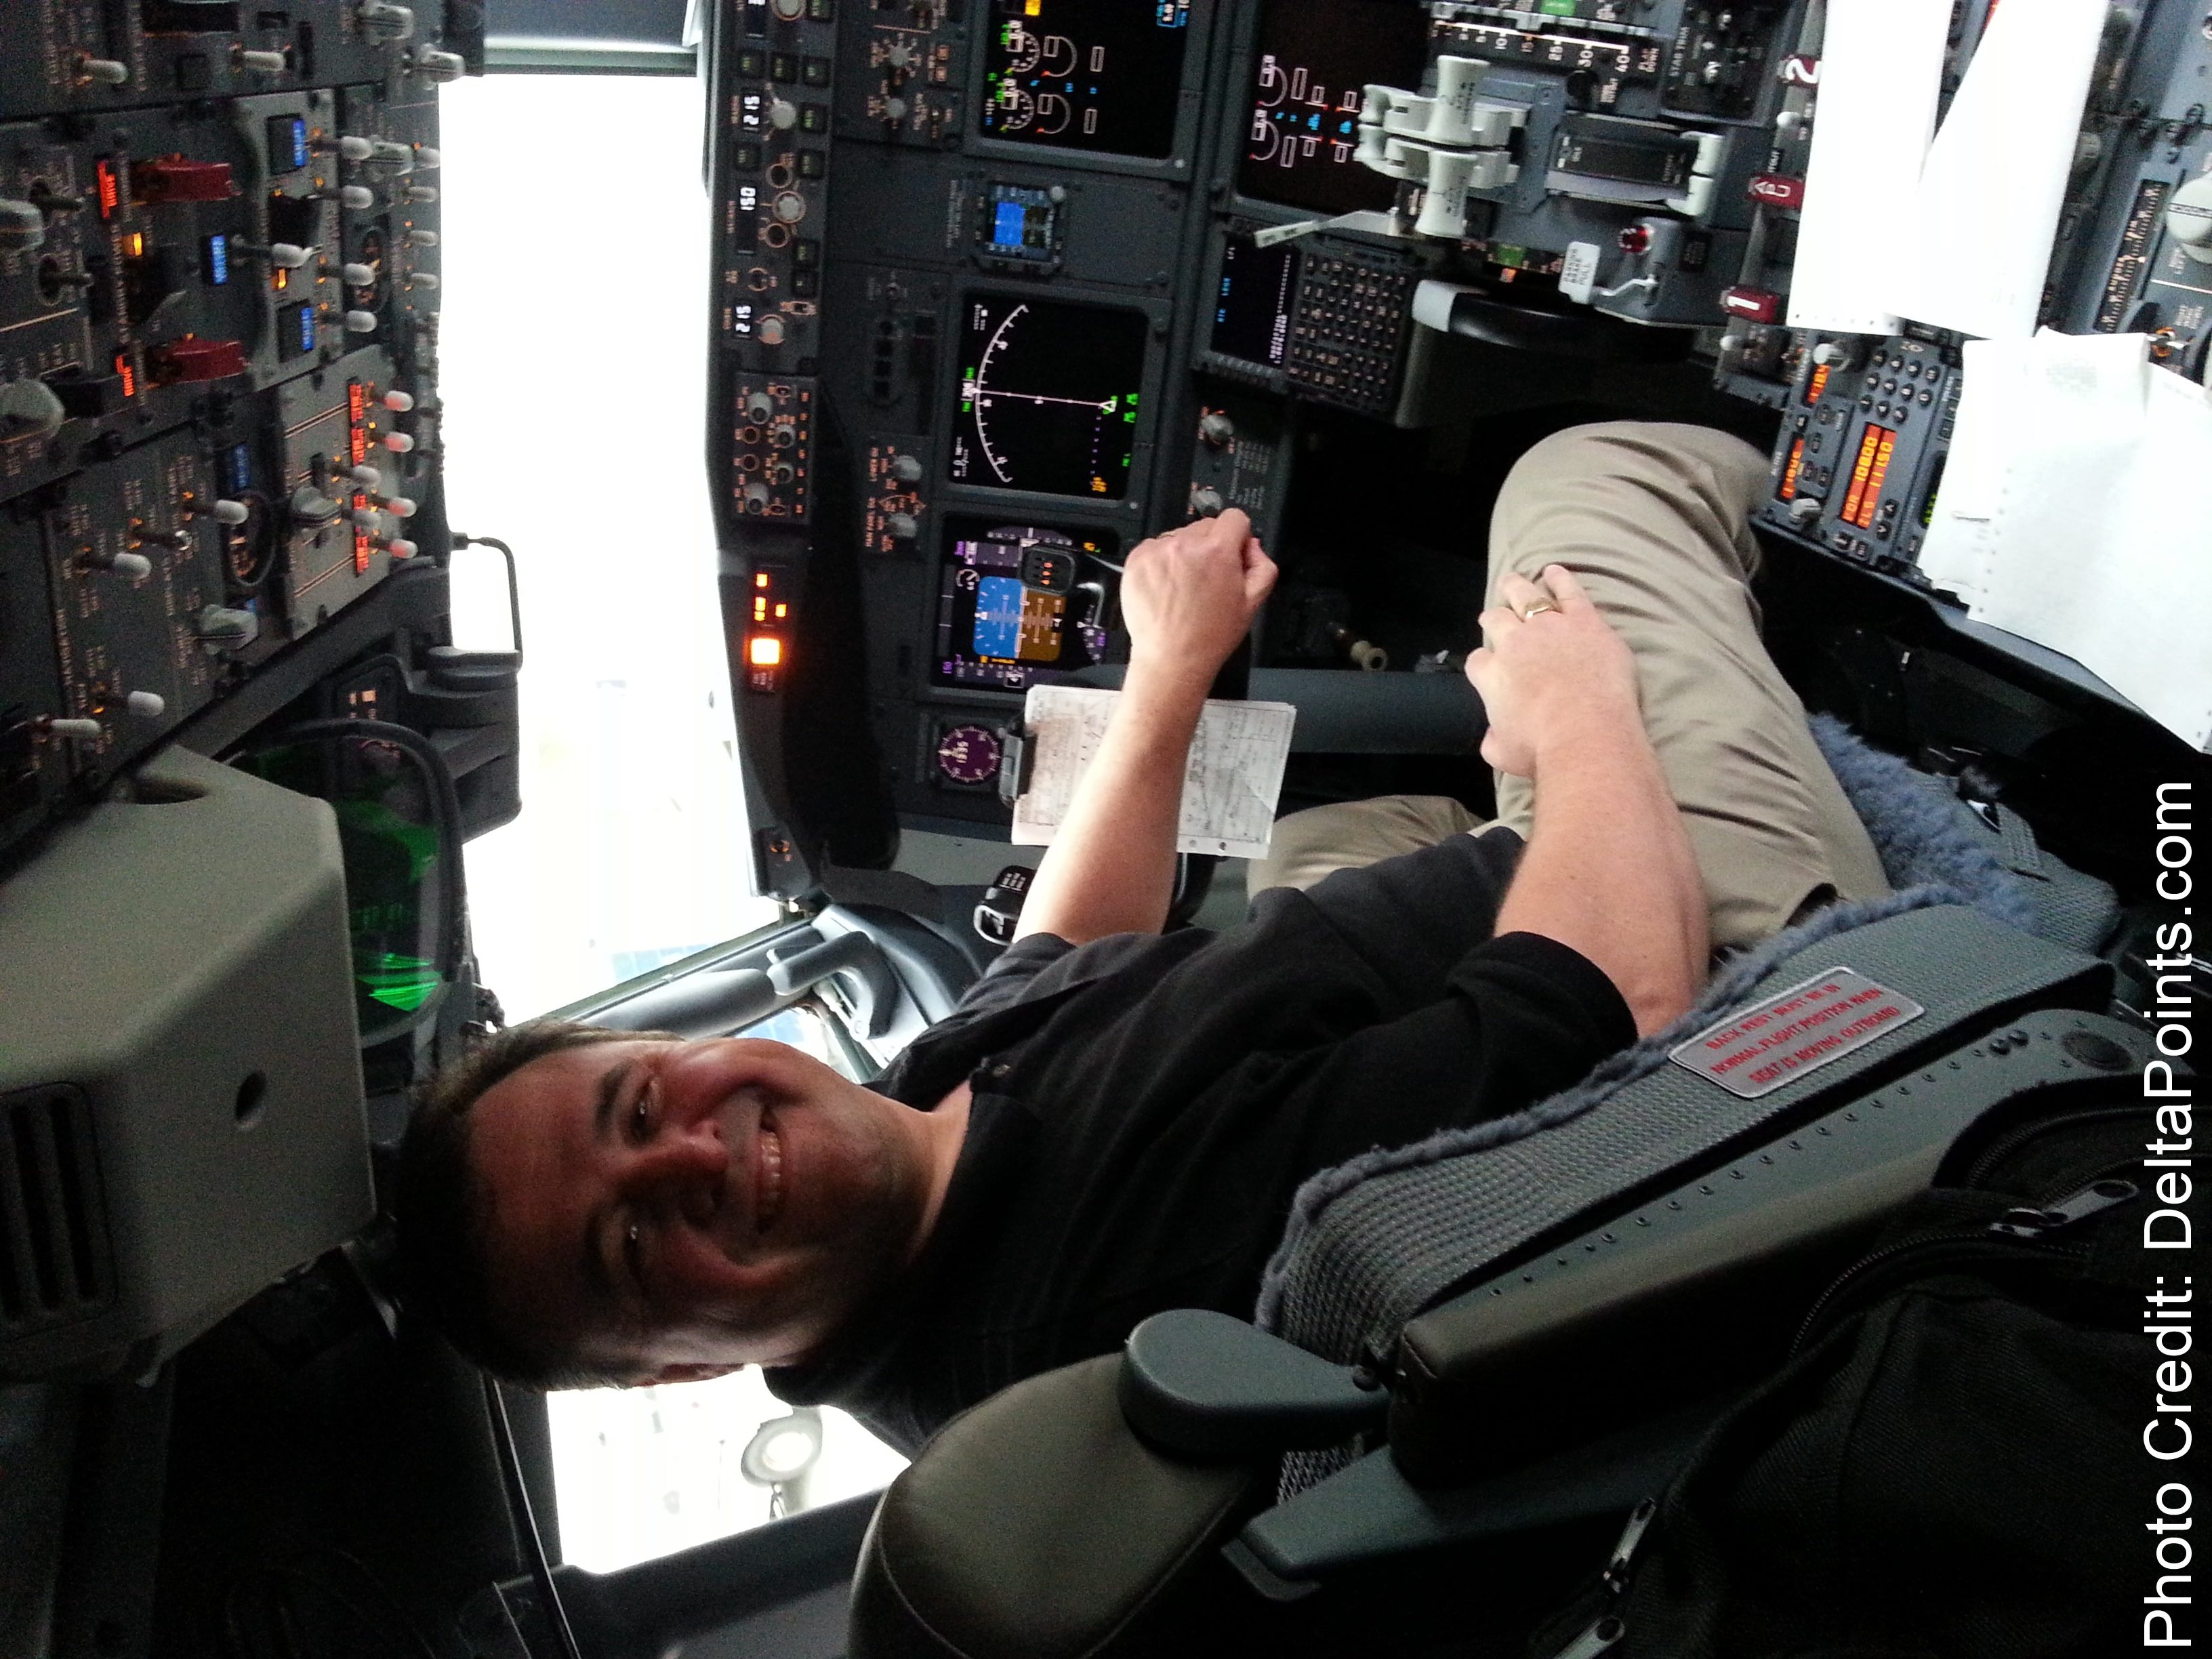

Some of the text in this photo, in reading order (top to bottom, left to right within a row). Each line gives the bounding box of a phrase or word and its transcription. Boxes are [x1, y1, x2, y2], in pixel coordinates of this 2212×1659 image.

[1494, 37, 1508, 50] 10
[1577, 49, 1594, 68] 30
[1614, 55, 1631, 73] 40
[1784, 58, 1822, 85] 2
[739, 186, 756, 211] 150
[1727, 295, 1760, 310] 1
